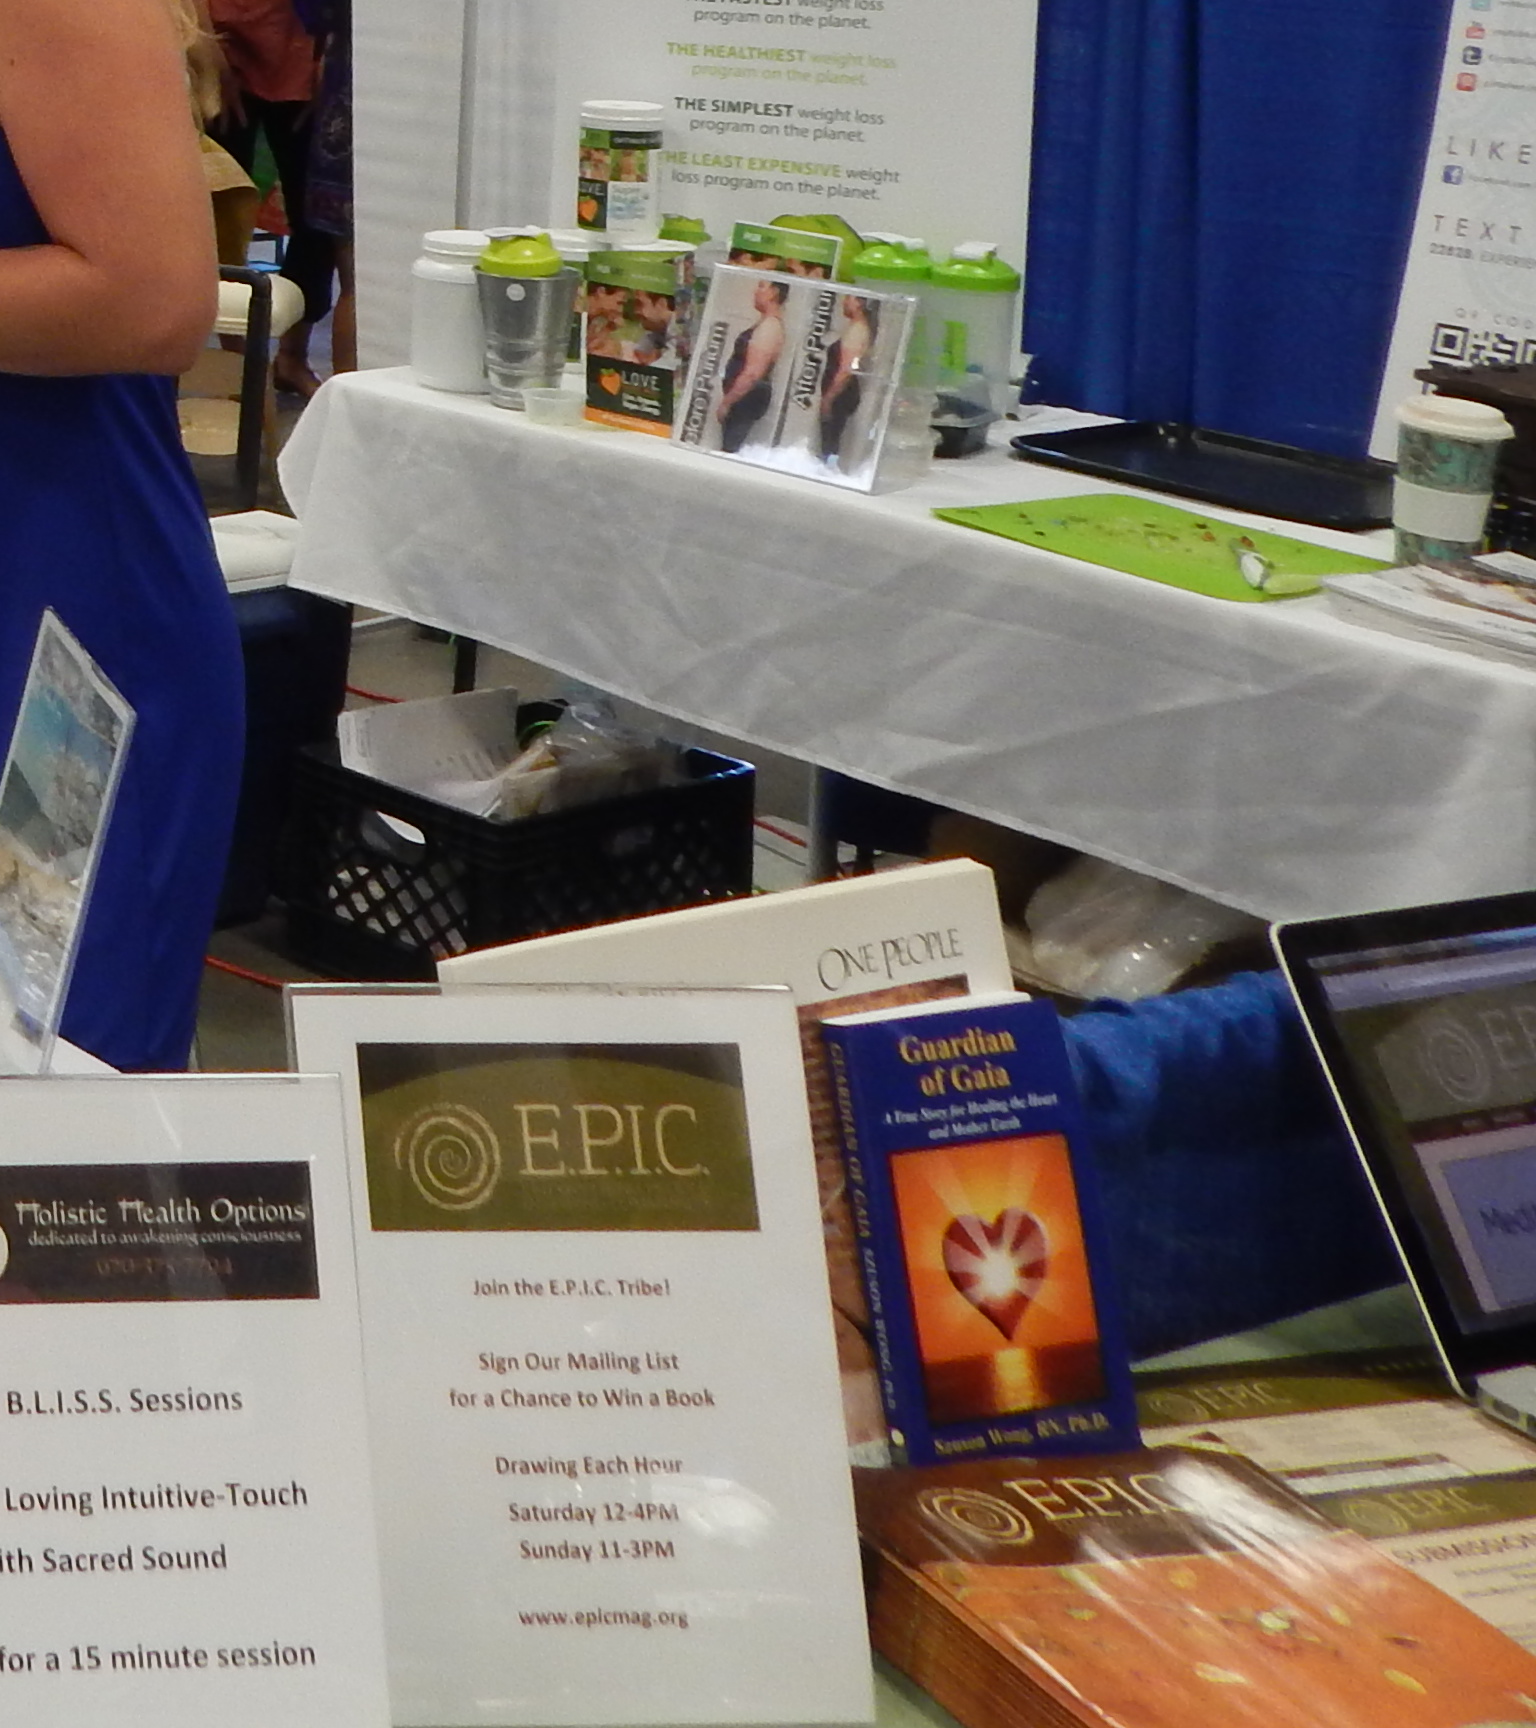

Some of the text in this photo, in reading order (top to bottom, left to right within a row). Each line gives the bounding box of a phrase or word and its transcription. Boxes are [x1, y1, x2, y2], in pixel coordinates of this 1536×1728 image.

[693, 8, 871, 33] program on the planet.
[666, 41, 699, 58] THE
[704, 44, 806, 63] HEALTHIEST
[674, 97, 885, 125] THE SIMPLEST weight loss
[689, 118, 865, 144] program on the planet.
[1446, 134, 1533, 165] LIKE
[692, 152, 743, 171] LEAST
[747, 156, 841, 178] EXPENSIVE
[845, 165, 900, 184] weight
[671, 168, 881, 201] loss program on the planet.
[1433, 214, 1523, 244] TEXT
[621, 369, 660, 392] LOVE
[818, 927, 964, 993] ONE PEOPLE
[899, 1027, 1017, 1065] Guardian
[921, 1060, 1011, 1097] of Gaia
[16, 1196, 307, 1228] Holistic Health Options
[28, 1229, 303, 1249] dedicated to awakening consciousness
[473, 1278, 671, 1299] Join the E.P.I.C. Tribe!
[478, 1352, 680, 1375] Sign Our Mailing List
[6, 1390, 122, 1417] B.L.I.S.S.
[129, 1386, 244, 1413] Sessions
[449, 1388, 716, 1408] for a Chance to Win a Book
[495, 1456, 683, 1478] Drawing Each Hour
[4, 1485, 94, 1517] Loving
[101, 1481, 309, 1510] Intuitive-Touch
[508, 1502, 679, 1526] Saturday 12-4PM
[42, 1545, 134, 1573] Sacred
[141, 1544, 229, 1571] Sound
[519, 1540, 676, 1563] Sunday 11-3PM
[518, 1608, 690, 1630] www.epicmag.org
[45, 1652, 61, 1671] a
[70, 1646, 102, 1671] 15
[109, 1643, 209, 1671] minute
[216, 1640, 317, 1667] session
